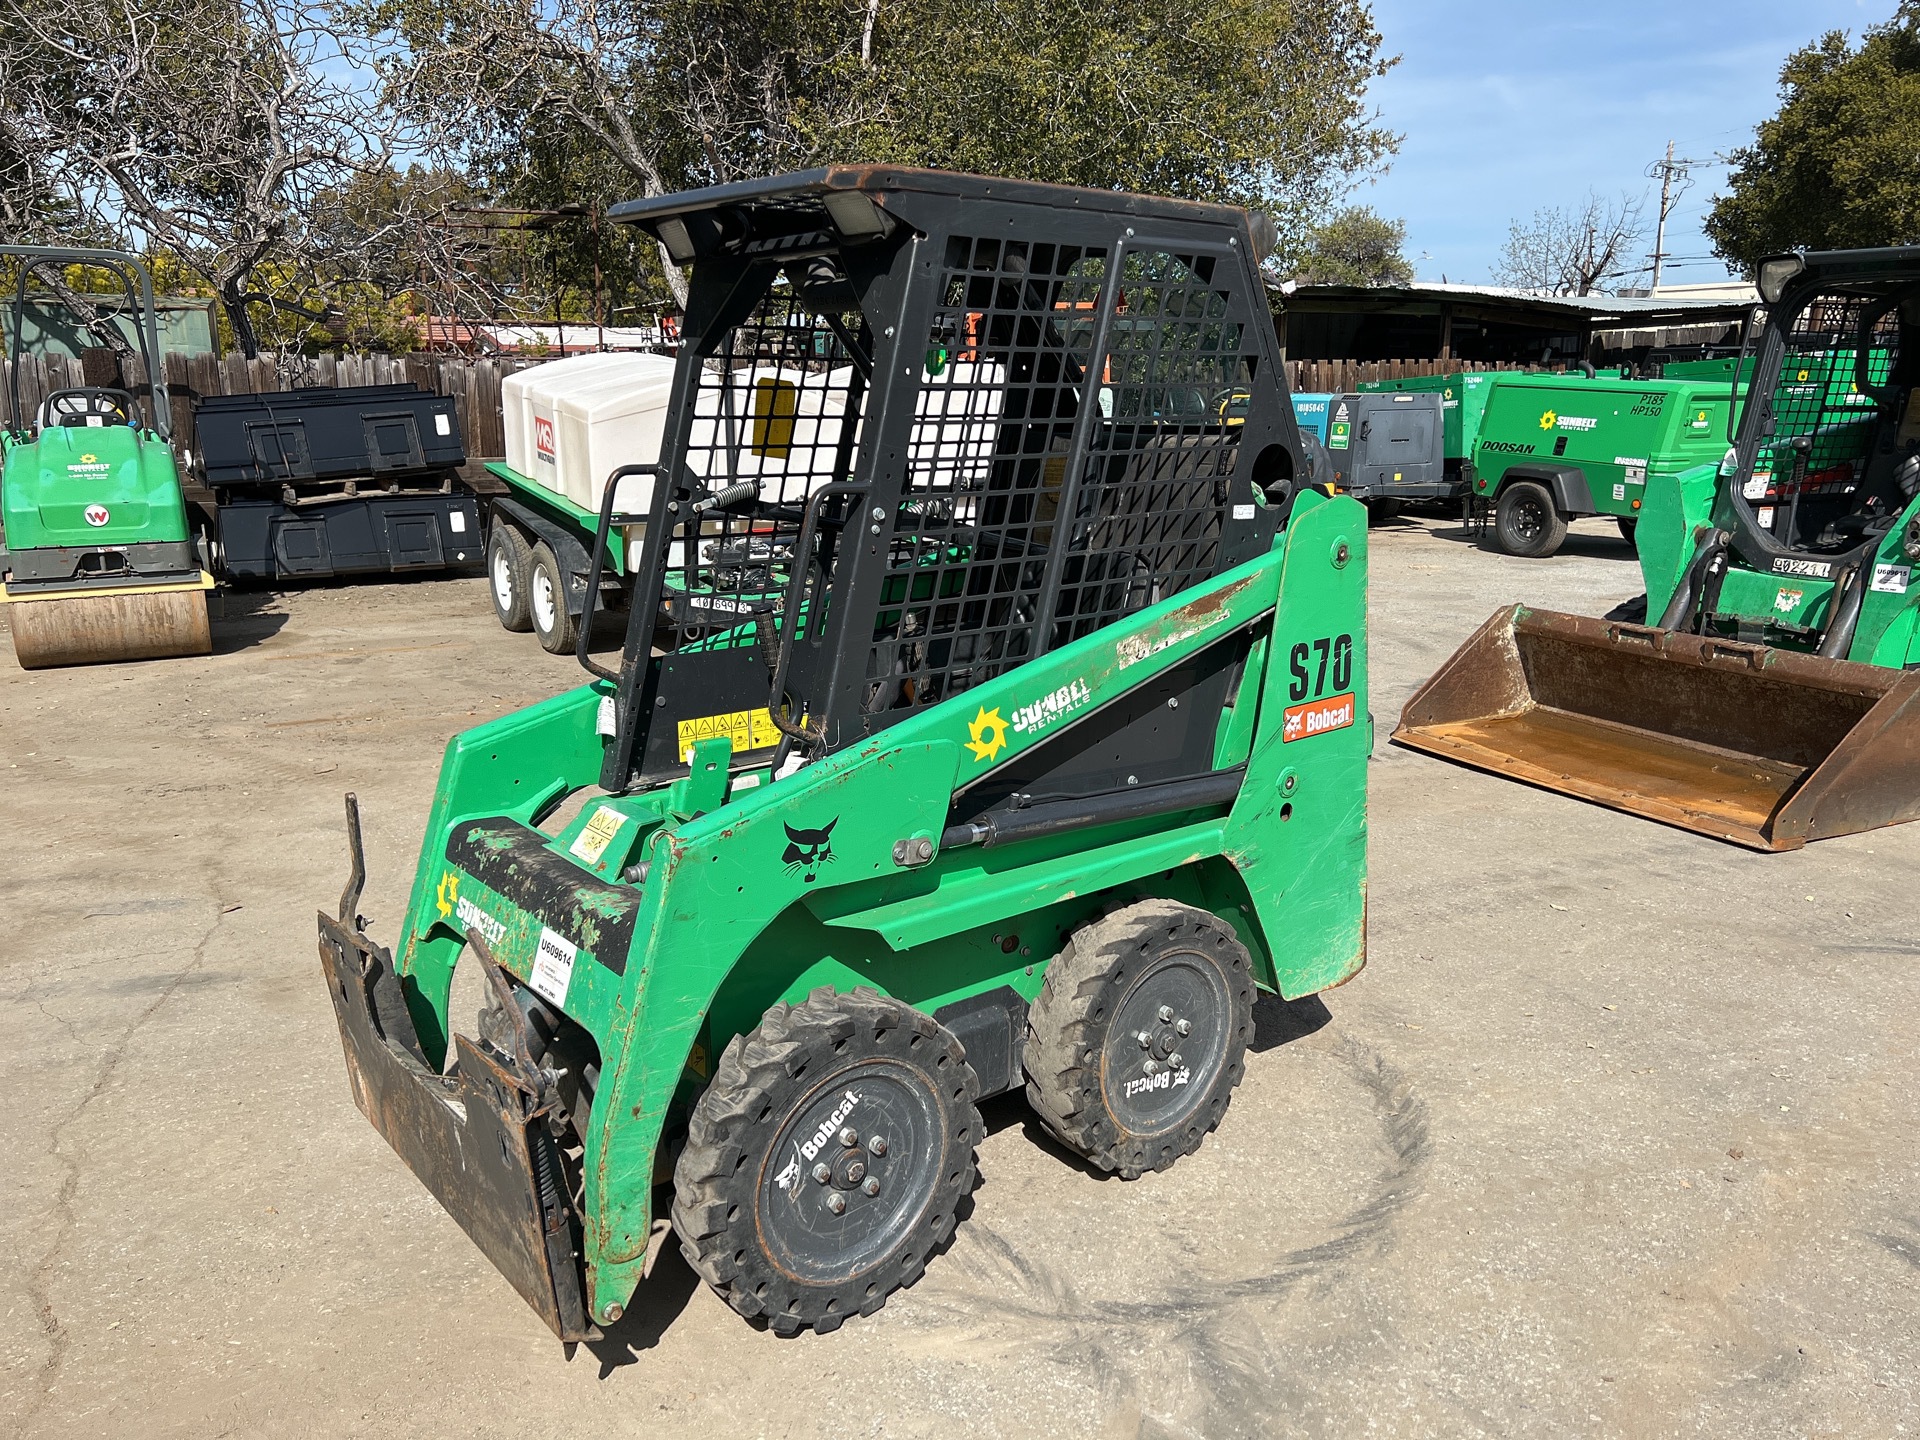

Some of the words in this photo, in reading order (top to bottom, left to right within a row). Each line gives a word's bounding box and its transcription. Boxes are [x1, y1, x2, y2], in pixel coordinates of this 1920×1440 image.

[1556, 415, 1598, 429] SUNBELT
[1629, 405, 1662, 417] HP150
[1560, 424, 1589, 432] RENTALS
[1481, 440, 1536, 455] DOOSAN
[1289, 633, 1352, 702] S70
[1027, 692, 1092, 735] RENTALS
[1306, 703, 1351, 733] Bobcat
[541, 938, 573, 968] U609614
